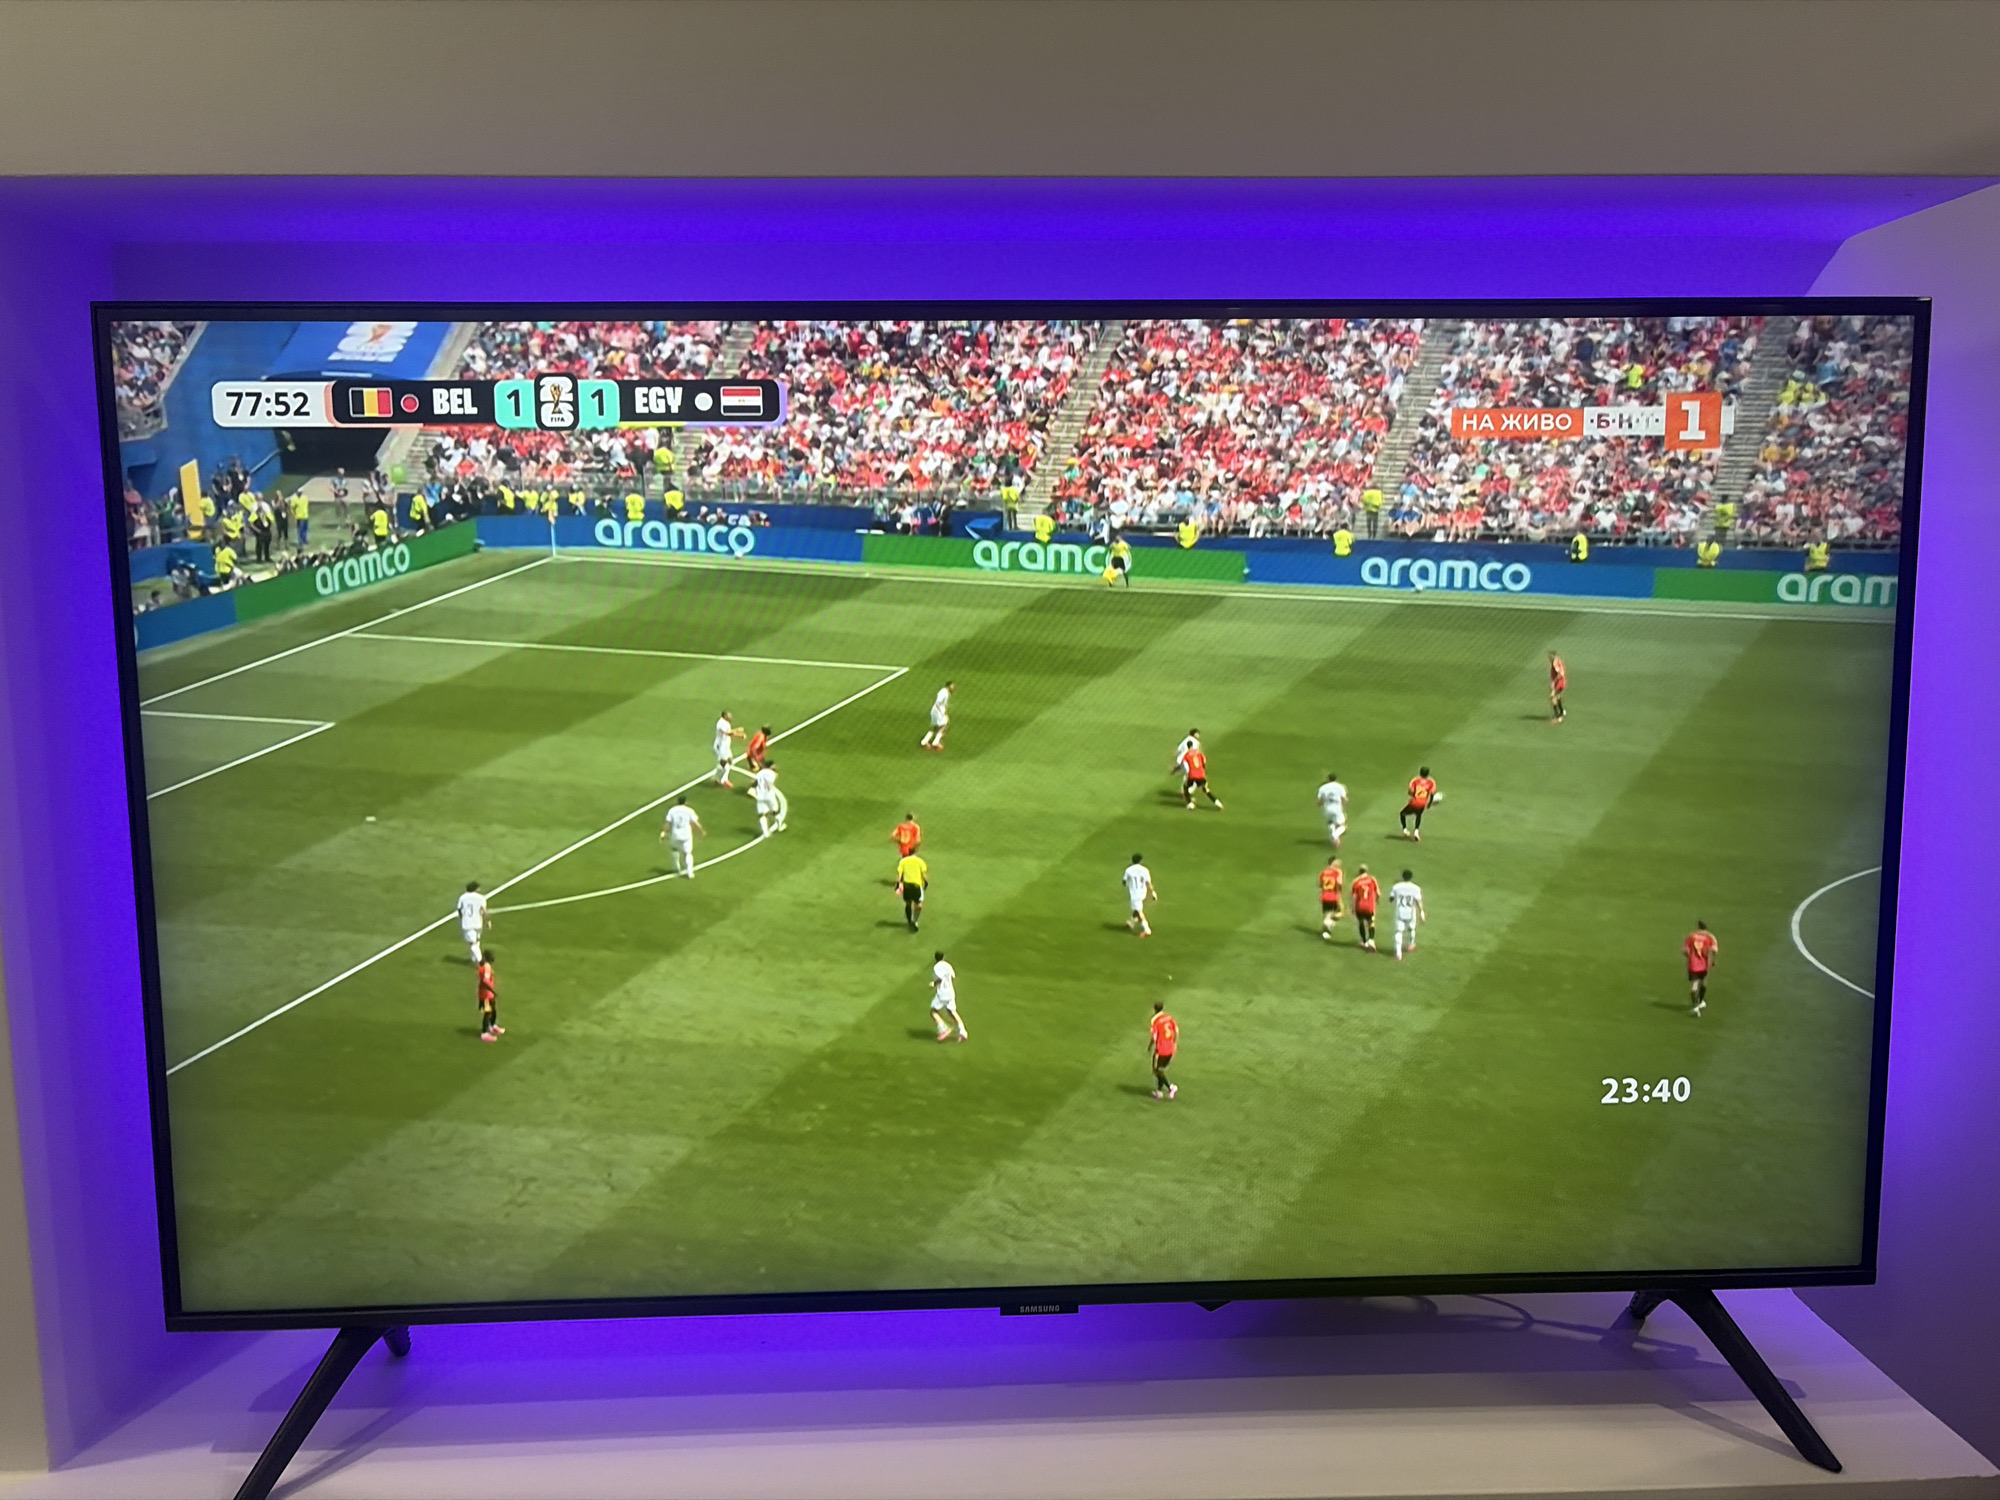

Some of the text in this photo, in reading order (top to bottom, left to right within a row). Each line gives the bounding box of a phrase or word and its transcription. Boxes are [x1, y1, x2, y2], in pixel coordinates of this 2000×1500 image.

[225, 386, 683, 418] 77:52 BEL 1 1 EGY
[1461, 412, 1573, 431] НА ЖИВО
[1678, 400, 1706, 440] 1
[594, 518, 756, 555] aramco
[315, 542, 411, 596] aramco
[1360, 556, 1532, 592] aramco
[1776, 572, 1899, 605] aram
[1600, 1076, 1692, 1104] 23:40
[1019, 1304, 1060, 1313] SAMSUNG
